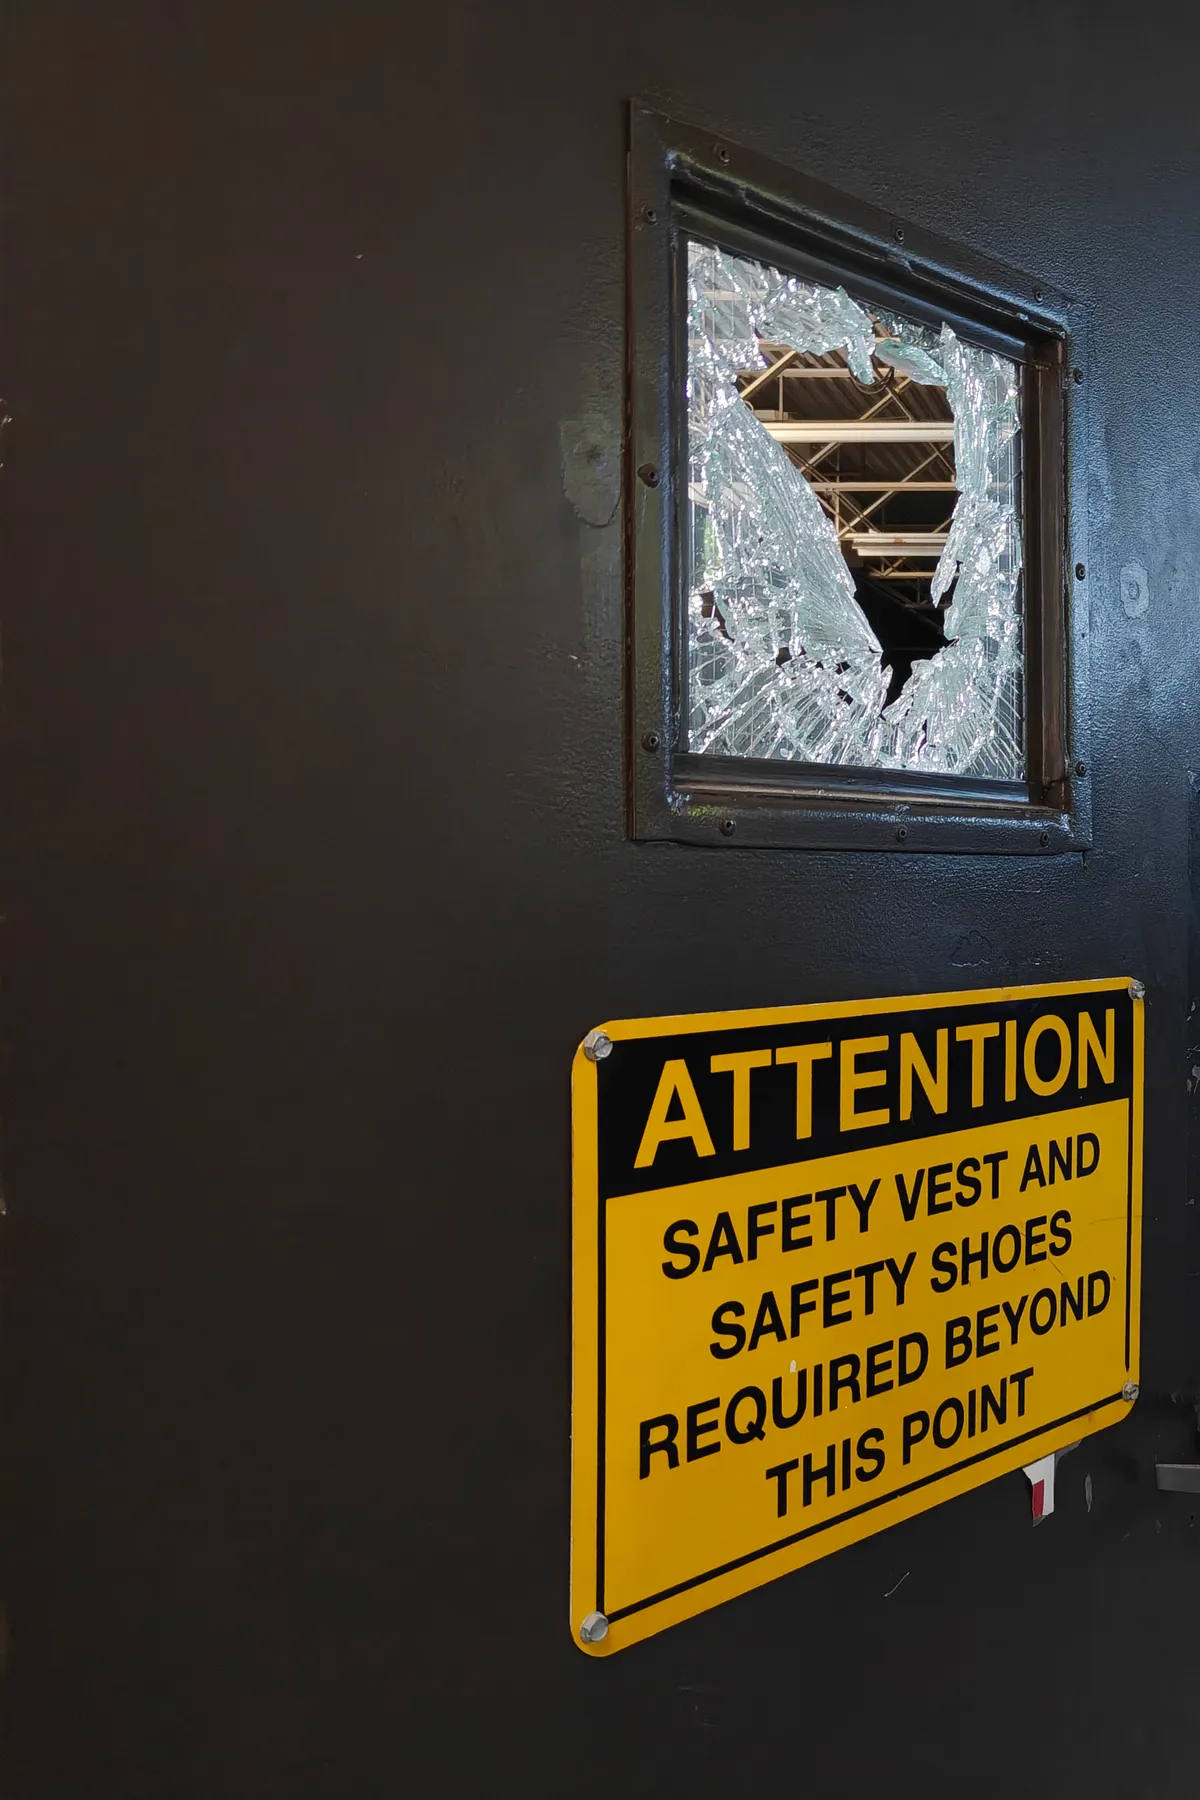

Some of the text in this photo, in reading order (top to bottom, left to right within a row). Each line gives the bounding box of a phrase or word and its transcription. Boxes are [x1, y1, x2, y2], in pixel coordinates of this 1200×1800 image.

[634, 1008, 1115, 1169] ATTENTION
[661, 1132, 1100, 1280] SAFETY VEST AND
[709, 1209, 1072, 1360] SAFETY SHOES
[639, 1270, 1111, 1480] REQUIRED BEYOND
[765, 1366, 1034, 1518] THIS POINT
